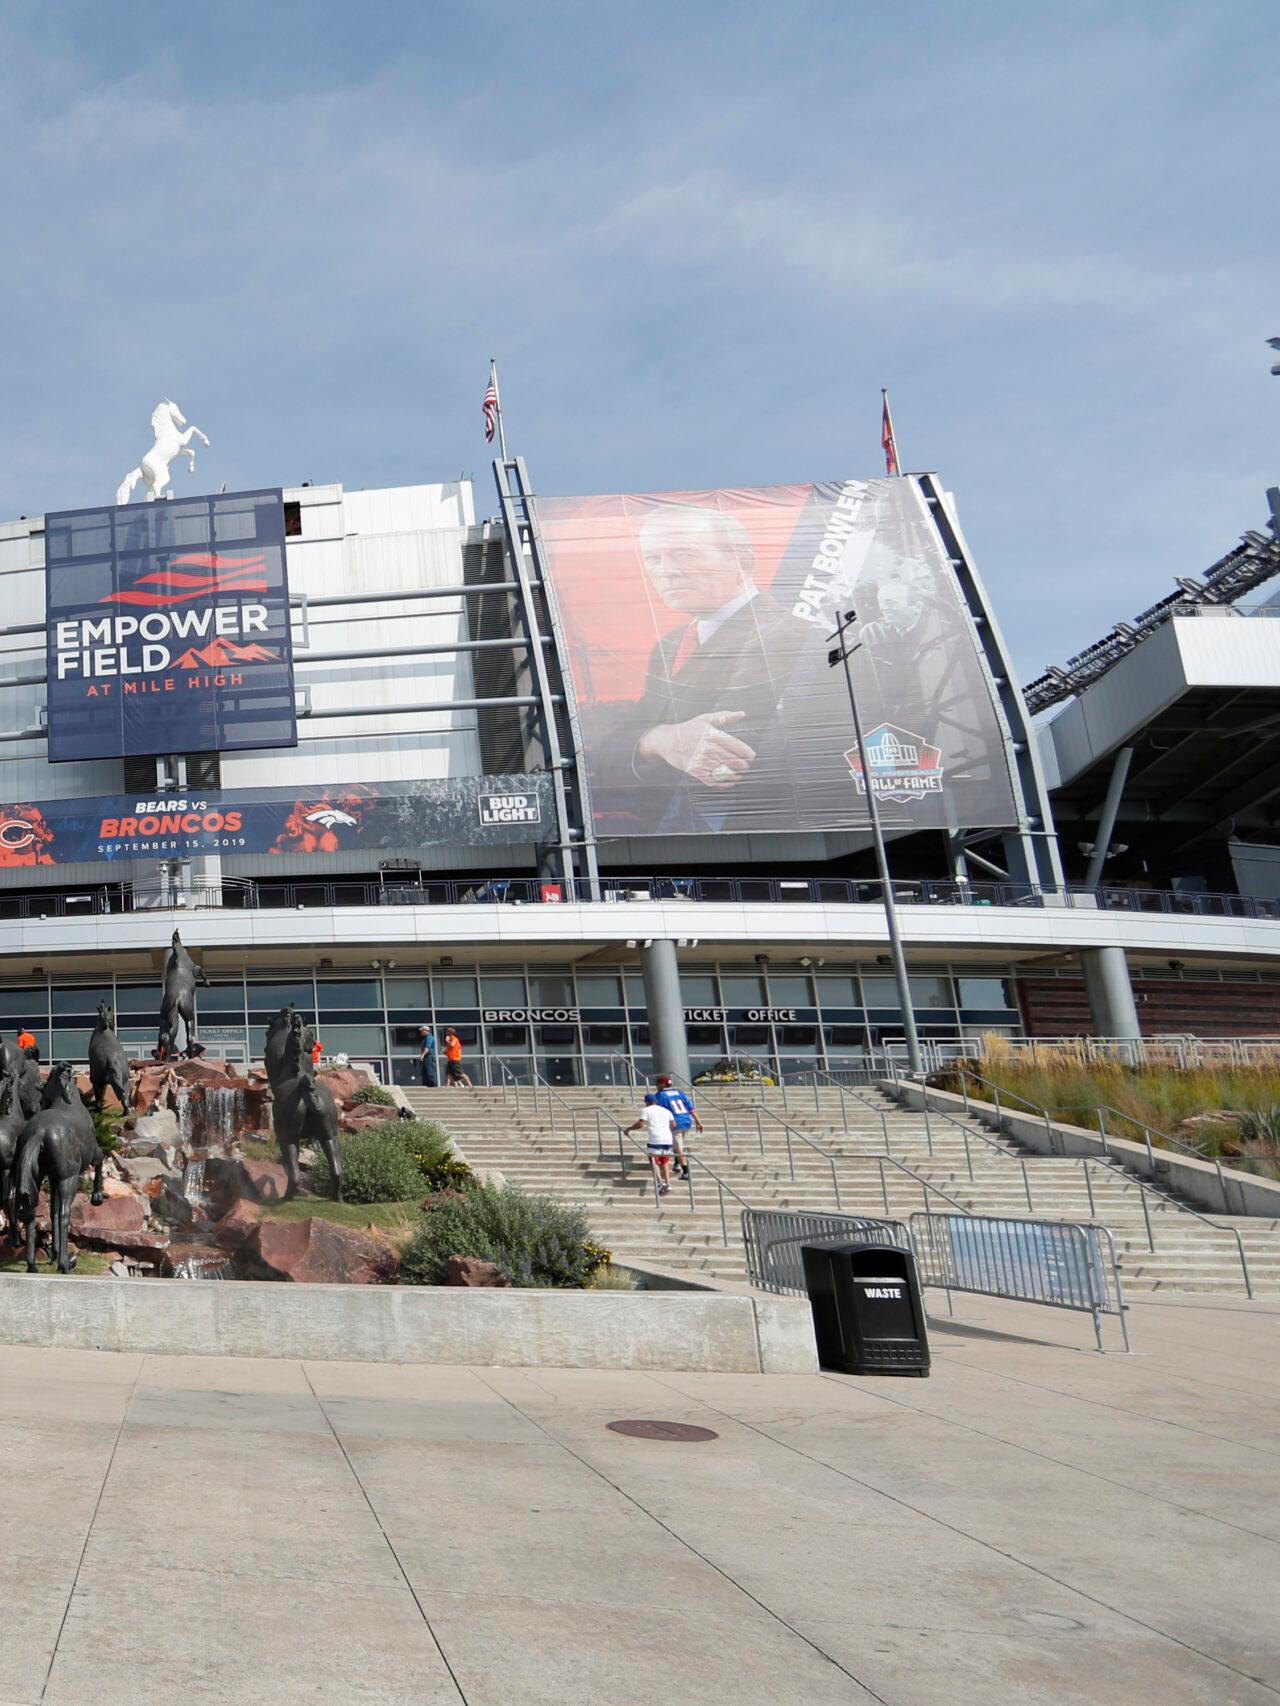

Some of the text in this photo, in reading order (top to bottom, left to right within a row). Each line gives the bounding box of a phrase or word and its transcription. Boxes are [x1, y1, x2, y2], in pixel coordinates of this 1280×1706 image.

[791, 480, 869, 622] PAT BOWLEN
[56, 604, 269, 649] EMPOWER
[57, 644, 170, 680] FIELD
[86, 673, 244, 697] AT MILE HIGH
[903, 777, 938, 789] FAME
[135, 800, 187, 813] BEARS
[489, 796, 528, 810] BUD
[483, 807, 536, 822] LIGHT
[99, 811, 242, 838] BRONCOS
[97, 841, 177, 853] SEPTEMBER
[213, 838, 245, 847] 2019
[485, 1010, 580, 1021] BRONCOS
[683, 1009, 797, 1021] TICKET OFFICE
[670, 1099, 688, 1114] 11
[864, 1288, 901, 1299] WASTE
